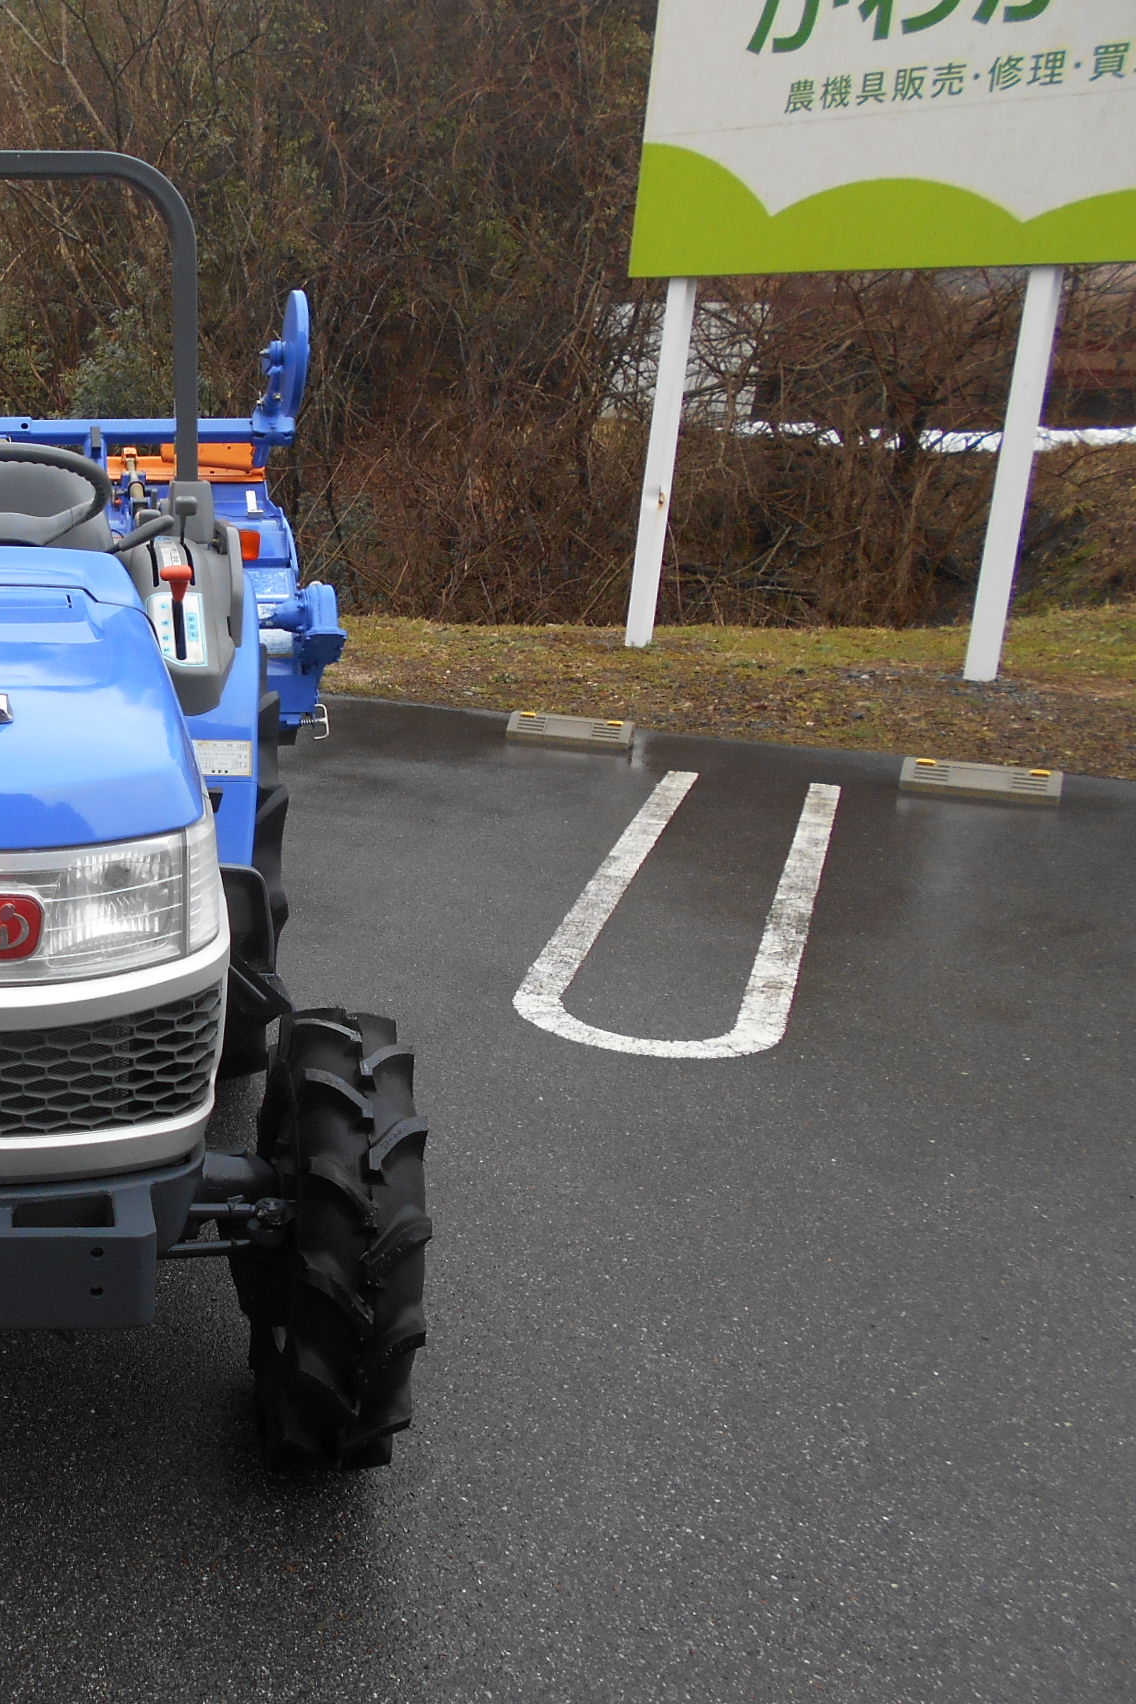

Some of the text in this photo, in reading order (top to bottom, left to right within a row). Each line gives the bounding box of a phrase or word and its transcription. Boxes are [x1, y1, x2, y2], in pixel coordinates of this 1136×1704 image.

[784, 42, 1136, 114] 農機具販売・修理・買
